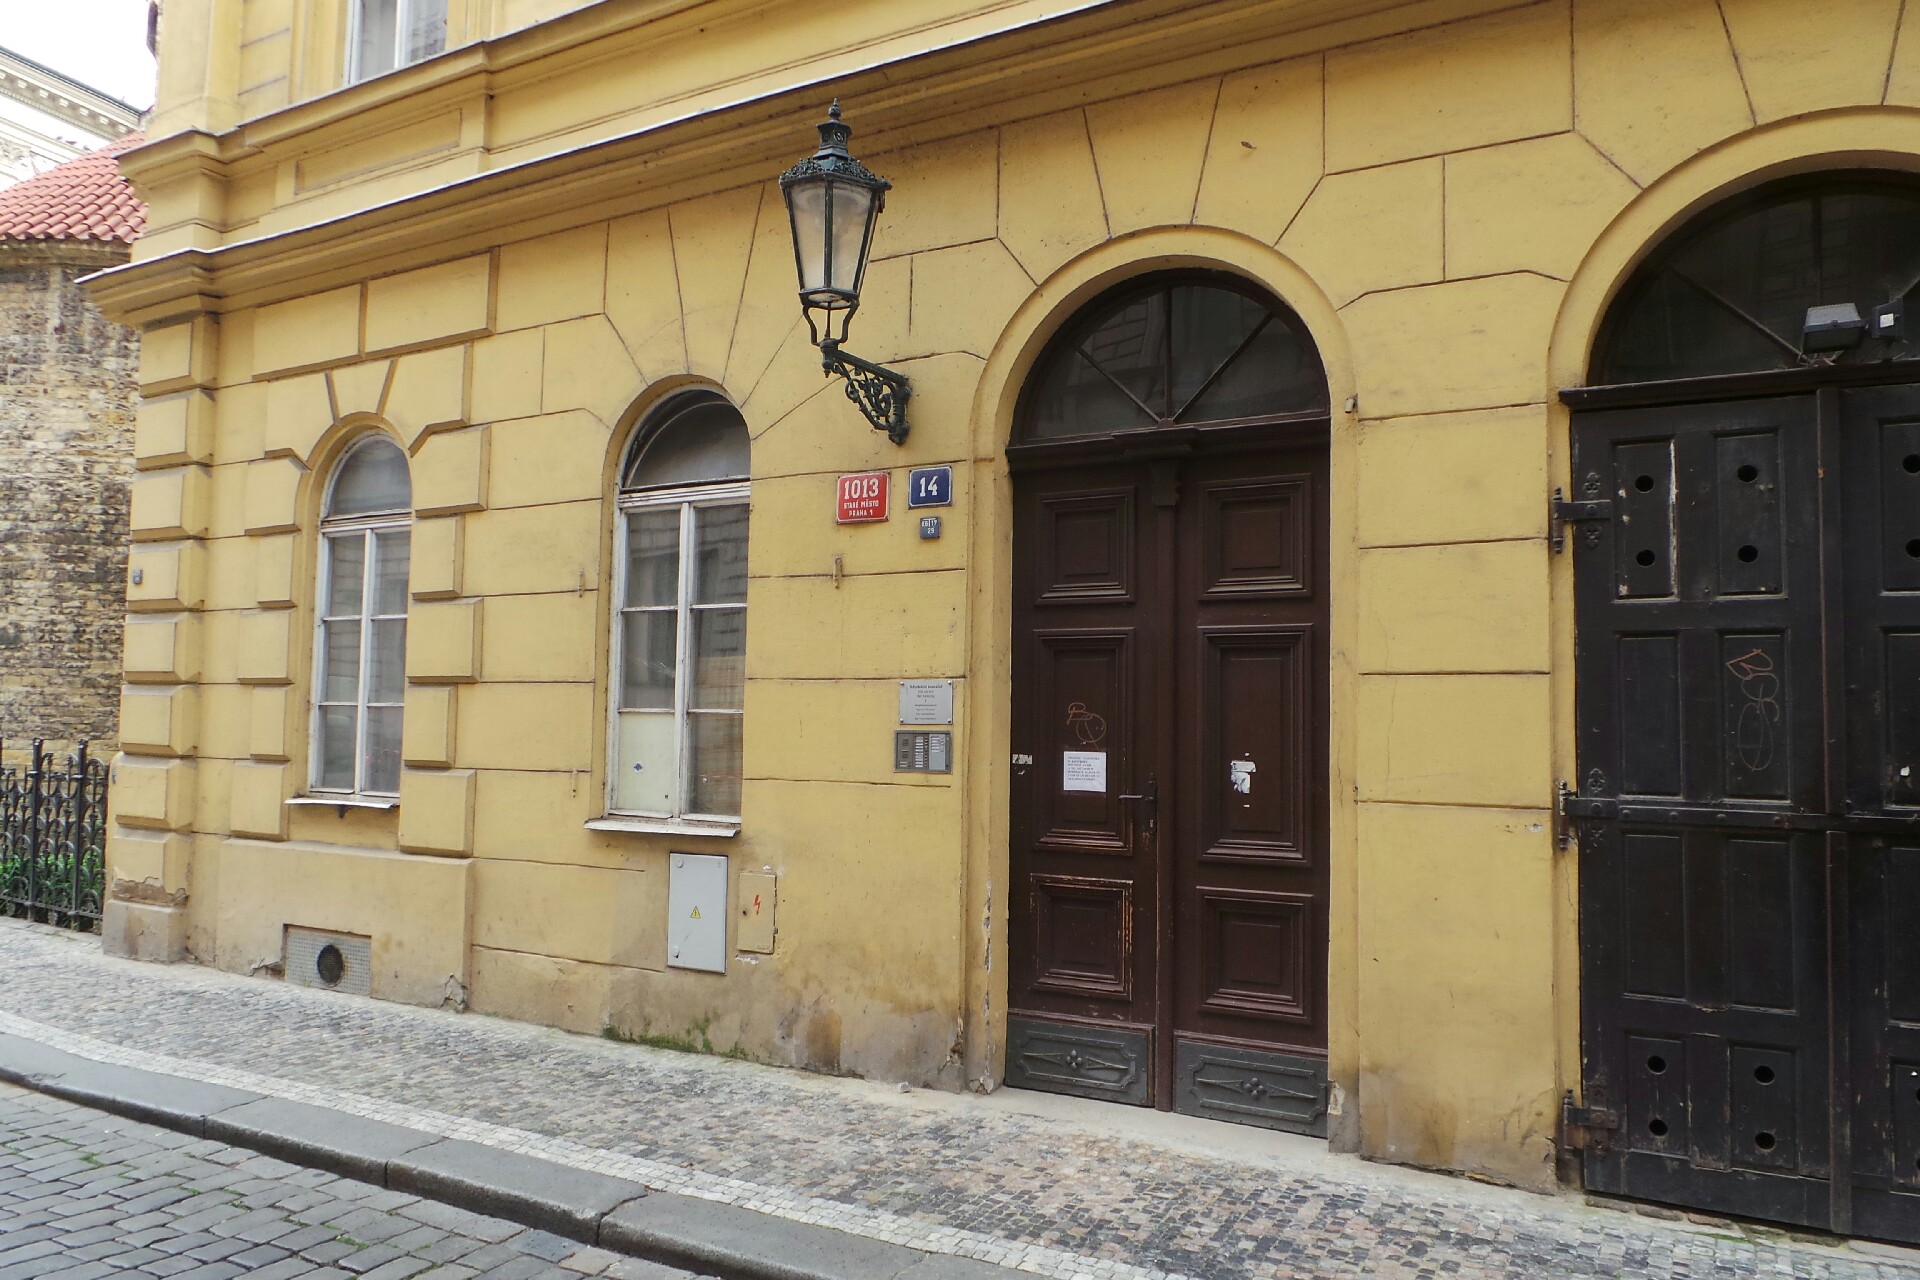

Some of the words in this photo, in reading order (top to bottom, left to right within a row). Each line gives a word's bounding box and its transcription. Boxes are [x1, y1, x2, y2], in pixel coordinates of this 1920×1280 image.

[844, 478, 879, 500] 1013
[919, 475, 938, 498] 14
[843, 499, 859, 510] STARÉ
[860, 498, 879, 508] MĚSTO
[848, 509, 868, 517] PRAHA
[869, 508, 873, 516] 1
